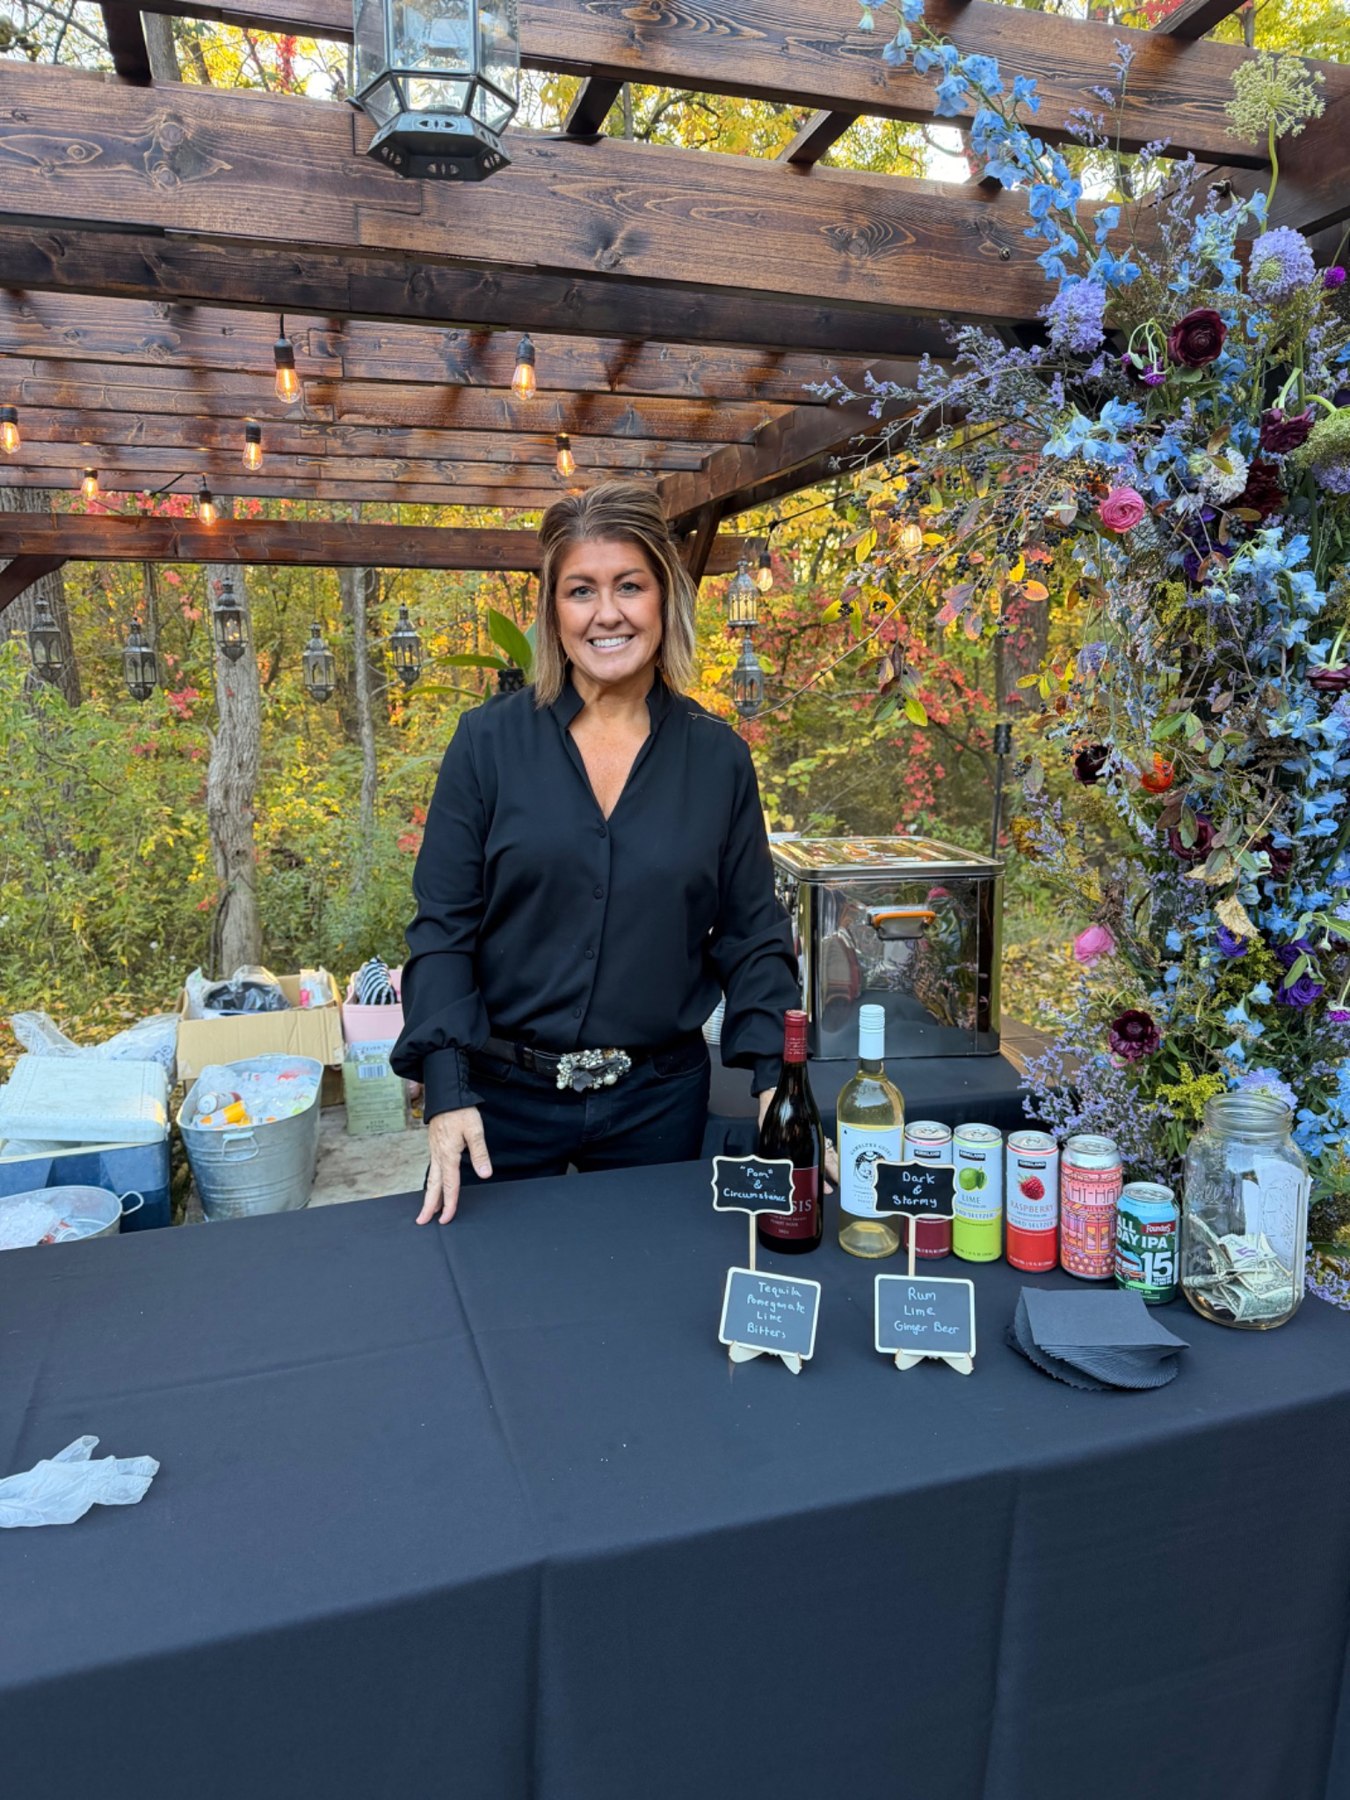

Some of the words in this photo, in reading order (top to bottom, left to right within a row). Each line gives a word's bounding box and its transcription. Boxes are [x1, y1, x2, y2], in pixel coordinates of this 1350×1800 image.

[902, 1171, 935, 1184] Dark
[753, 1180, 763, 1189] &
[892, 1195, 937, 1208] Stormy
[962, 1194, 982, 1204] LIME
[1010, 1200, 1054, 1213] RASPBERRY
[1118, 1215, 1137, 1234] ALL
[1116, 1228, 1140, 1247] DAY
[1141, 1235, 1168, 1249] IPA
[1140, 1251, 1173, 1286] 15
[758, 1281, 802, 1298] Tequila
[908, 1287, 936, 1301] Rum
[757, 1311, 782, 1323] Lime
[904, 1305, 936, 1316] Lime
[747, 1322, 786, 1339] Bitters
[894, 1320, 928, 1336] Ginger
[933, 1321, 960, 1335] Beer
